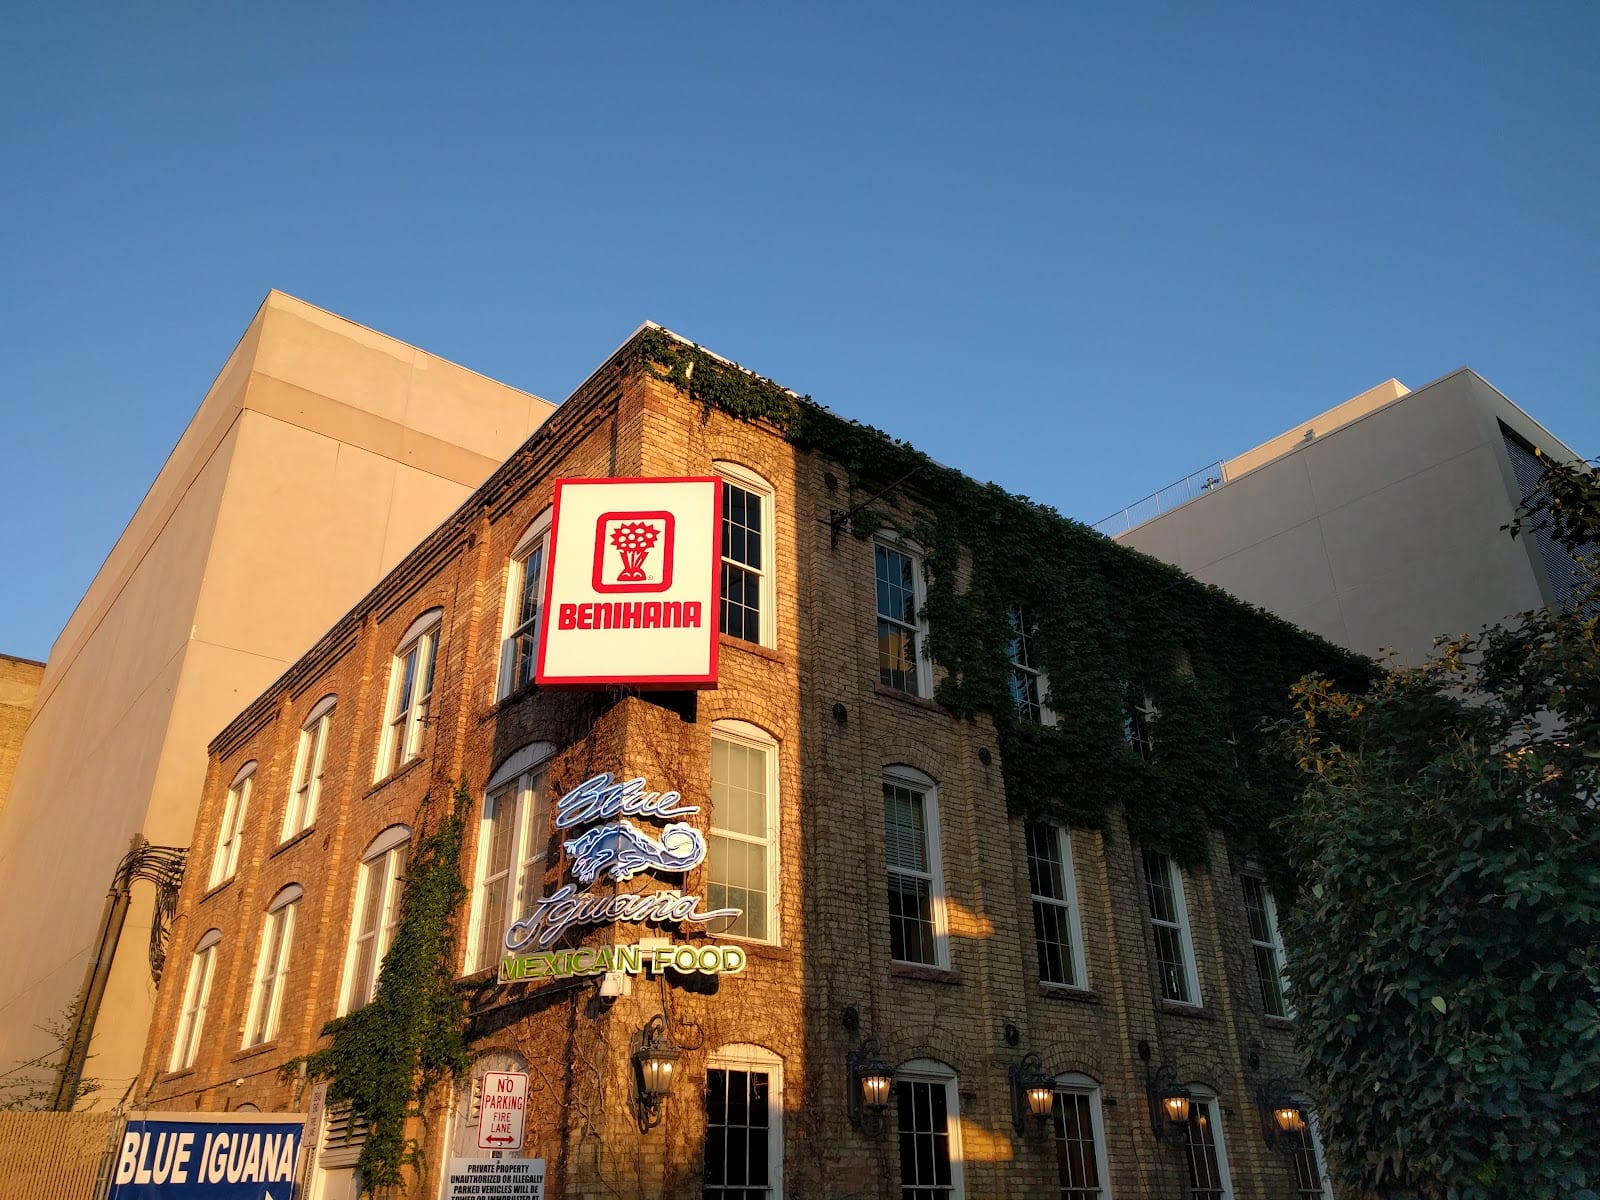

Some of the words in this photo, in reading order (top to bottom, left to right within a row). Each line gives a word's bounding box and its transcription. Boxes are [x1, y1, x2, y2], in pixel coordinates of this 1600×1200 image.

[558, 601, 702, 630] BENIHANA
[556, 772, 700, 829] Blue
[505, 884, 743, 949] Iguana
[499, 944, 642, 983] MEXICAN
[651, 944, 747, 975] FOOD
[497, 1079, 514, 1093] NO
[485, 1095, 523, 1110] PARKING
[493, 1112, 512, 1122] FIRE
[491, 1123, 512, 1133] LANE
[115, 1132, 195, 1185] BLUE
[197, 1132, 295, 1184] IGUANA
[467, 1164, 495, 1173] PRIVATE
[495, 1164, 530, 1173] PROPERTY
[450, 1175, 501, 1184] UNAUTHORIZED
[502, 1175, 512, 1183] OR
[512, 1175, 544, 1183] ILLEGALLY
[453, 1185, 480, 1194] PARKED
[481, 1185, 513, 1194] VEHICLES
[513, 1185, 530, 1193] WILL
[530, 1185, 539, 1193] BE
